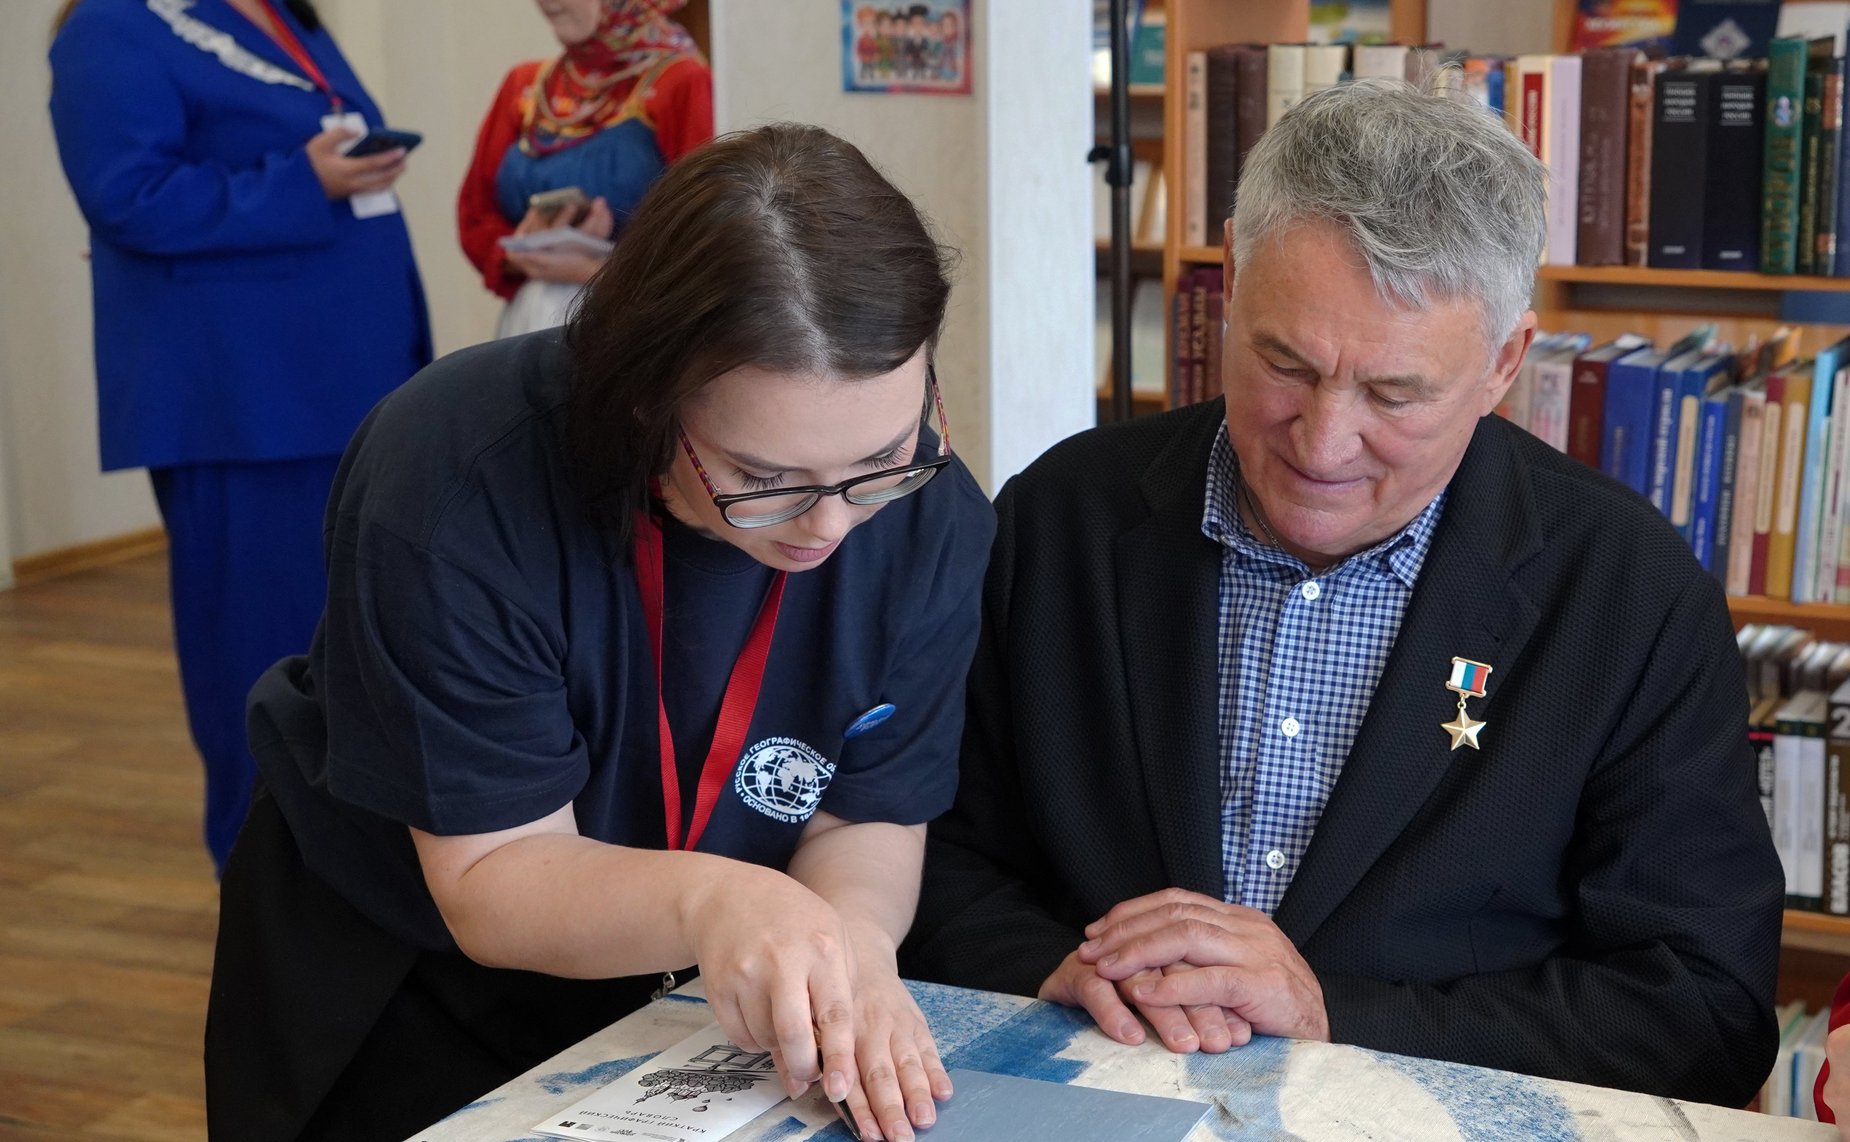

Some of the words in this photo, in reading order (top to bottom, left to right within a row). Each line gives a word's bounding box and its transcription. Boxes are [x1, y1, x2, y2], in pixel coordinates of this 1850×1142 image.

[734, 753, 750, 794] РУССКОЕ
[749, 737, 828, 766] ГЕОГРАФИЧЕСКОЕ
[743, 795, 790, 822] ОСНОВАНО
[790, 815, 798, 823] В
[579, 1110, 655, 1125] ГРАФИЧЕСКИЙ
[625, 1110, 679, 1121] СЛОВАРЬ
[657, 1121, 707, 1134] КРАТКИЙ
